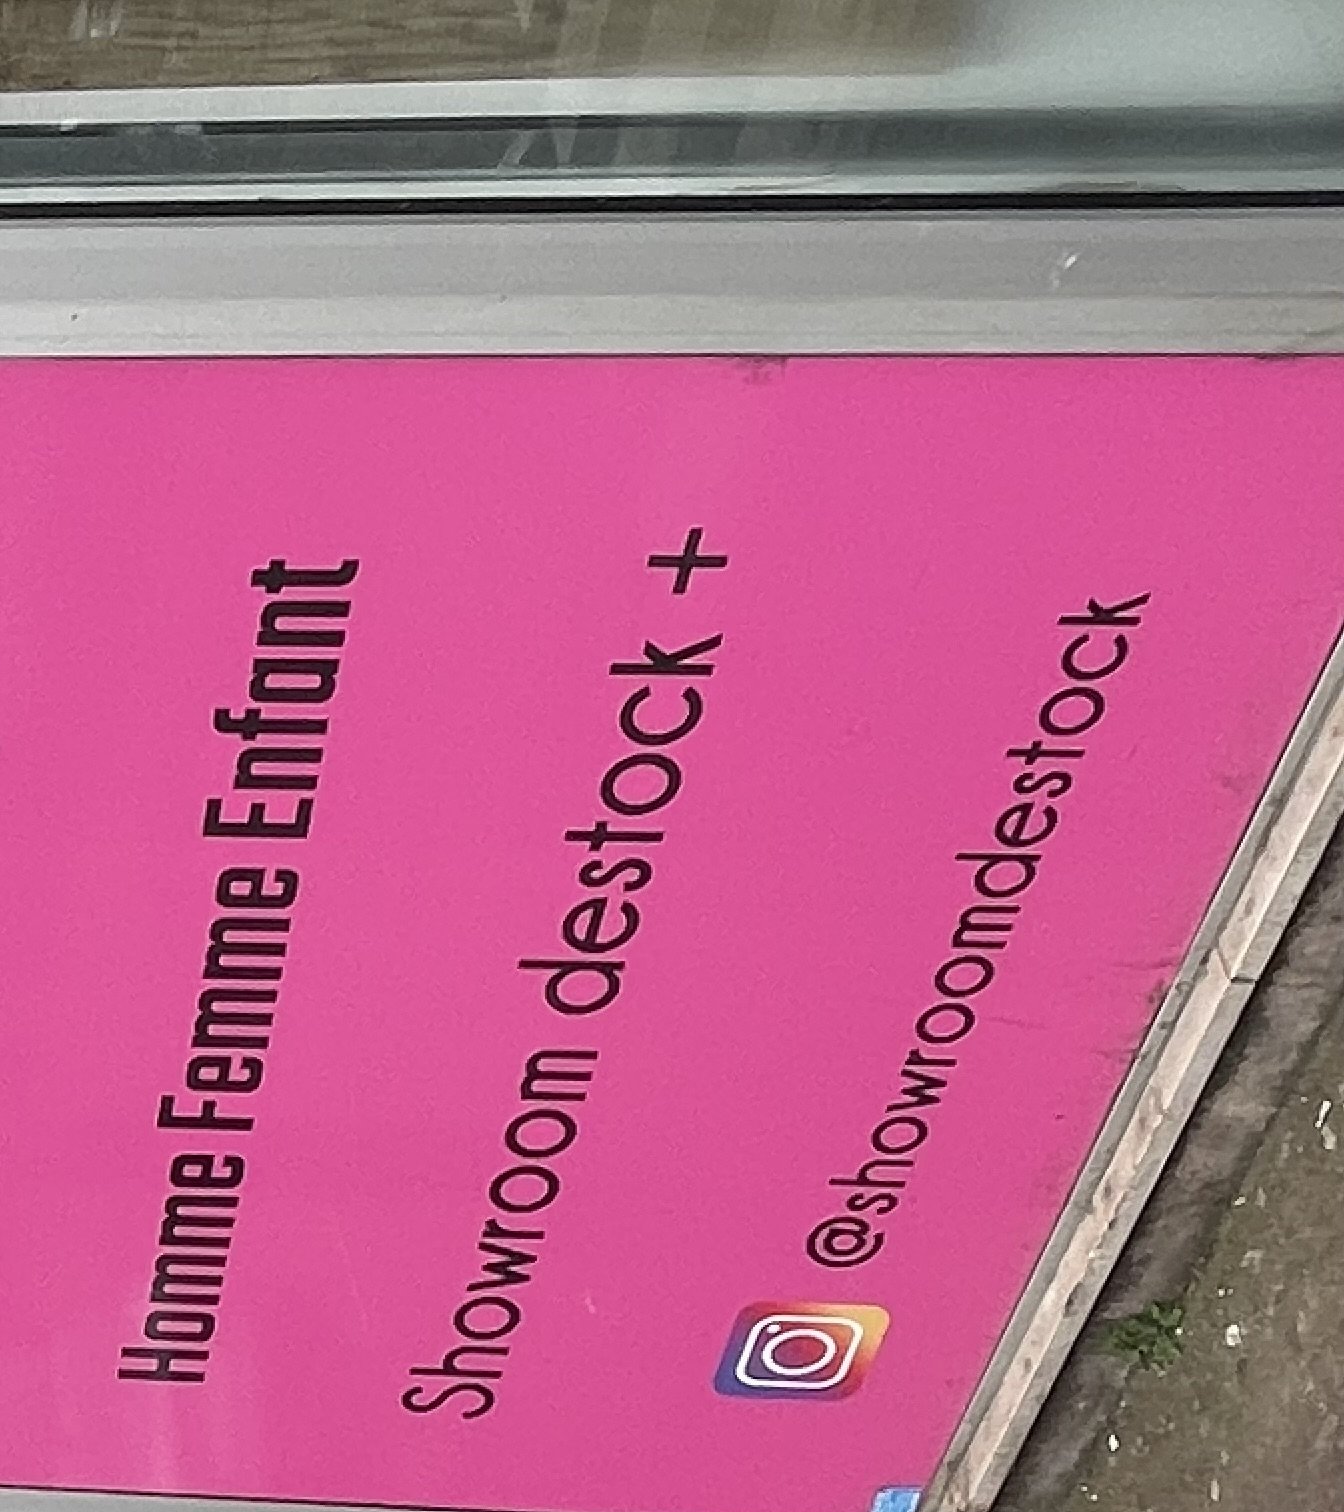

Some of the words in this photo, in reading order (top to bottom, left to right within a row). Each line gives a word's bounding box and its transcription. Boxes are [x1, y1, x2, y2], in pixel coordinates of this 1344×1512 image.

[202, 558, 360, 840] Enfant
[156, 866, 300, 1132] Femme
[400, 1049, 599, 1420] Showroom
[516, 632, 724, 1016] destock
[646, 526, 729, 596] +
[806, 592, 1152, 1268] @showroomdestock
[116, 1153, 246, 1384] Homme
